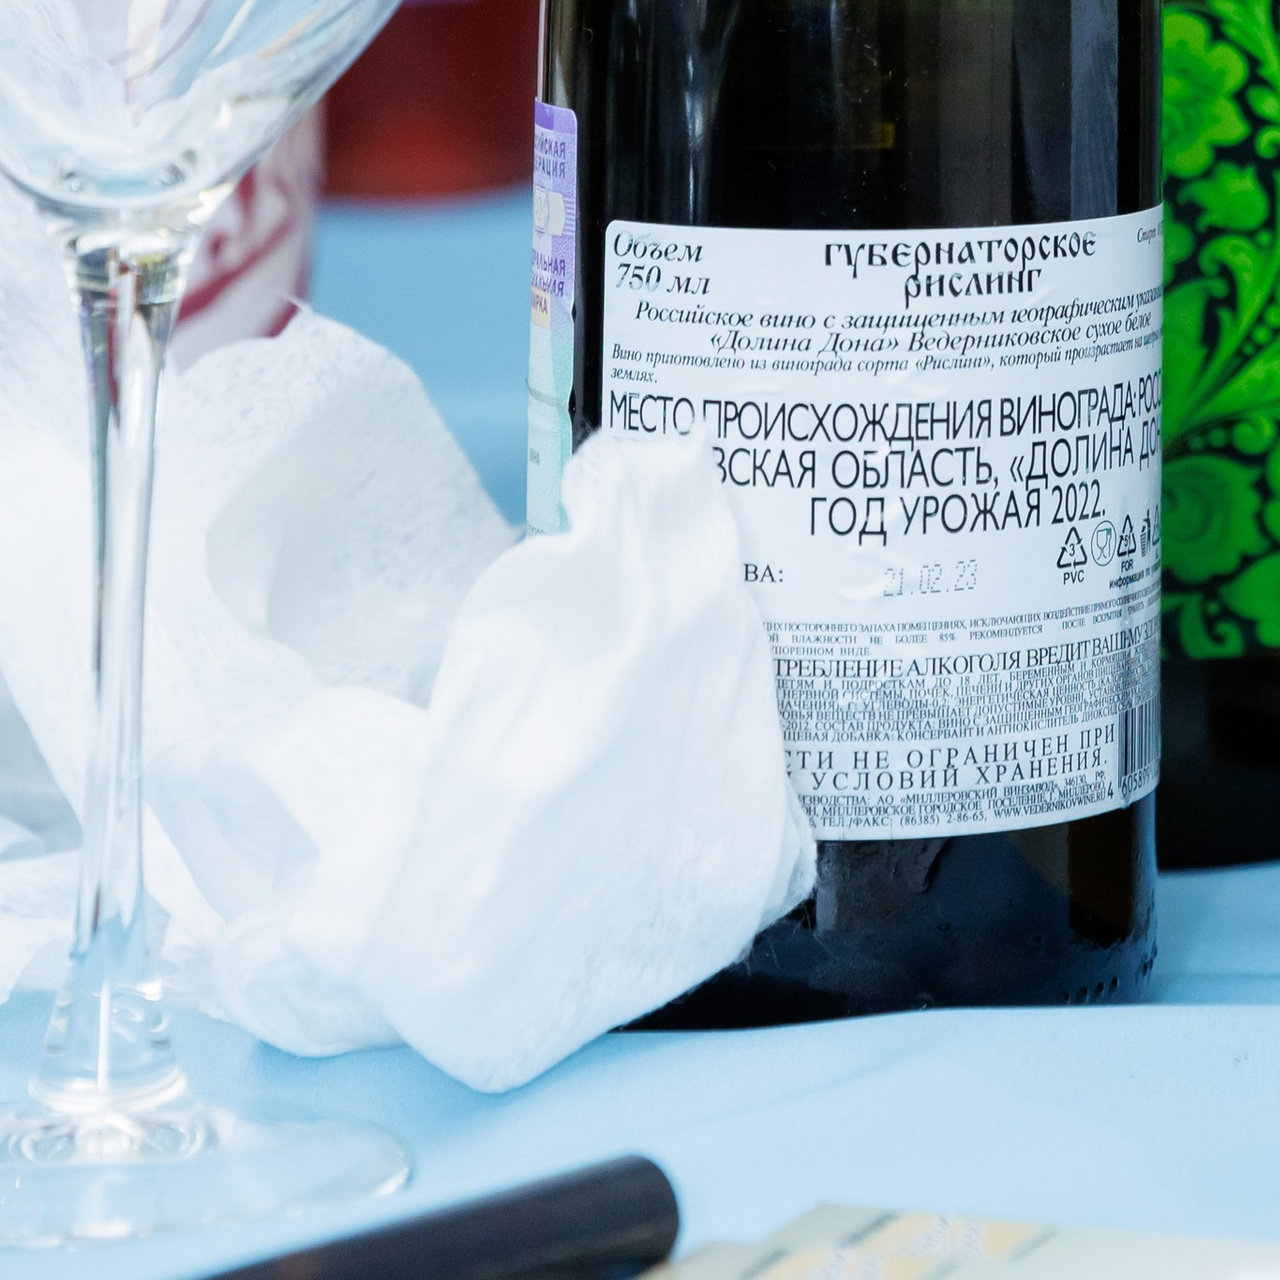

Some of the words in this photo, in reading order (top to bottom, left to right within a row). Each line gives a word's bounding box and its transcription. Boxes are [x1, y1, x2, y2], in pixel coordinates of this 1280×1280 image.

[613, 229, 704, 263] Объем
[615, 262, 662, 292] 750
[666, 274, 711, 296] мл
[634, 299, 754, 328] Российское
[759, 313, 816, 329] вино
[823, 314, 836, 329] с
[841, 309, 1005, 335] защищенным
[1011, 294, 1135, 327] географическим
[710, 329, 812, 355] «Долина
[817, 331, 899, 357] Дона»
[907, 326, 1081, 356] Ведерниковское
[1085, 319, 1122, 344] сухое
[1125, 311, 1152, 333] белое
[610, 366, 659, 384] землях.
[611, 343, 643, 363] Вино
[750, 358, 767, 371] из
[771, 354, 853, 377] винограда
[856, 357, 909, 377] сорта
[999, 346, 1062, 370] который
[609, 389, 696, 436] МЕСТО
[702, 398, 993, 451] ПРОИСХОЖДЕНИЯ
[1000, 381, 1136, 437] ВИНОГРАДА:
[831, 445, 999, 490] ОБЛАСТЬ,
[1009, 423, 1134, 491] «ДОЛИНА
[810, 496, 888, 547] ГОД
[899, 487, 1041, 537] УРОЖАЯ
[1051, 478, 1106, 525] 2022.
[1063, 569, 1085, 585] PVC
[1120, 558, 1134, 573] FOR
[791, 634, 857, 645] ВЛАЖНОСТИ
[895, 634, 928, 644] БОЛЕЕ
[772, 658, 904, 678] ТРЕБЛЕНИЕ
[906, 651, 1022, 678] АЛКОГОЛЯ
[1026, 639, 1090, 669] ВРЕДИТ
[841, 678, 926, 691] ПОДРОСТКАМ
[852, 750, 890, 770] НЕ
[906, 734, 1070, 768] ОГРАНИЧЕН
[1080, 723, 1115, 750] ПРИ
[810, 764, 959, 791] УСЛОВИЙ
[976, 747, 1108, 785] ХРАНЕНИЯ.
[876, 794, 895, 805] АО
[1107, 781, 1114, 800] 4
